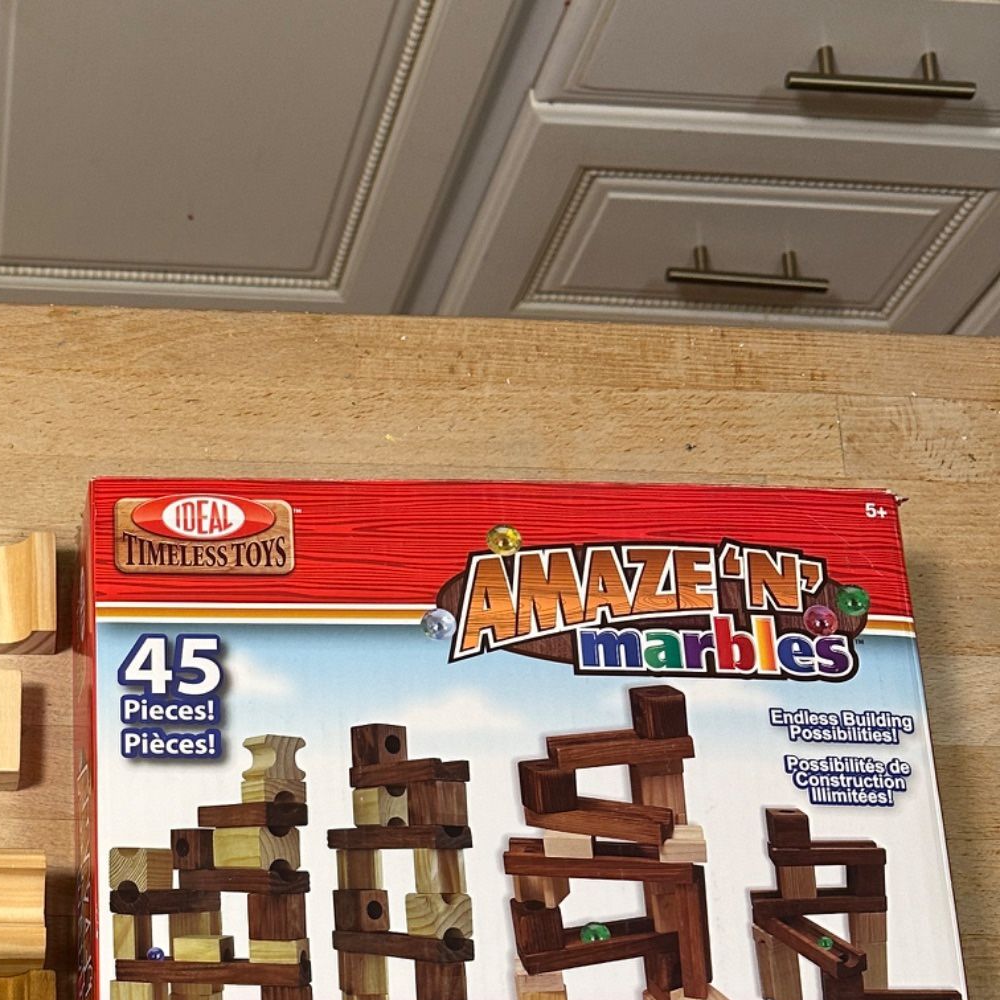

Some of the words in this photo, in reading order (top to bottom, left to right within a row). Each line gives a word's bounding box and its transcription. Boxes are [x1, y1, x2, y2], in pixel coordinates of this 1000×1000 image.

[175, 499, 234, 535] IDEAL
[865, 502, 888, 519] 5+
[122, 531, 228, 567] TIMELESS
[231, 535, 288, 568] TOYS
[456, 546, 718, 654] AMAZE
[578, 613, 855, 676] marbles
[123, 636, 222, 696] 45
[123, 699, 215, 721] Pieces!
[770, 709, 839, 726] Endless
[842, 711, 912, 731] Building
[124, 731, 216, 755] Pièces!
[789, 725, 899, 743] Possibilities!
[786, 756, 885, 774] Possibilités
[888, 758, 911, 774] de
[795, 772, 906, 790] Construction
[811, 787, 894, 804] Illimitées!
